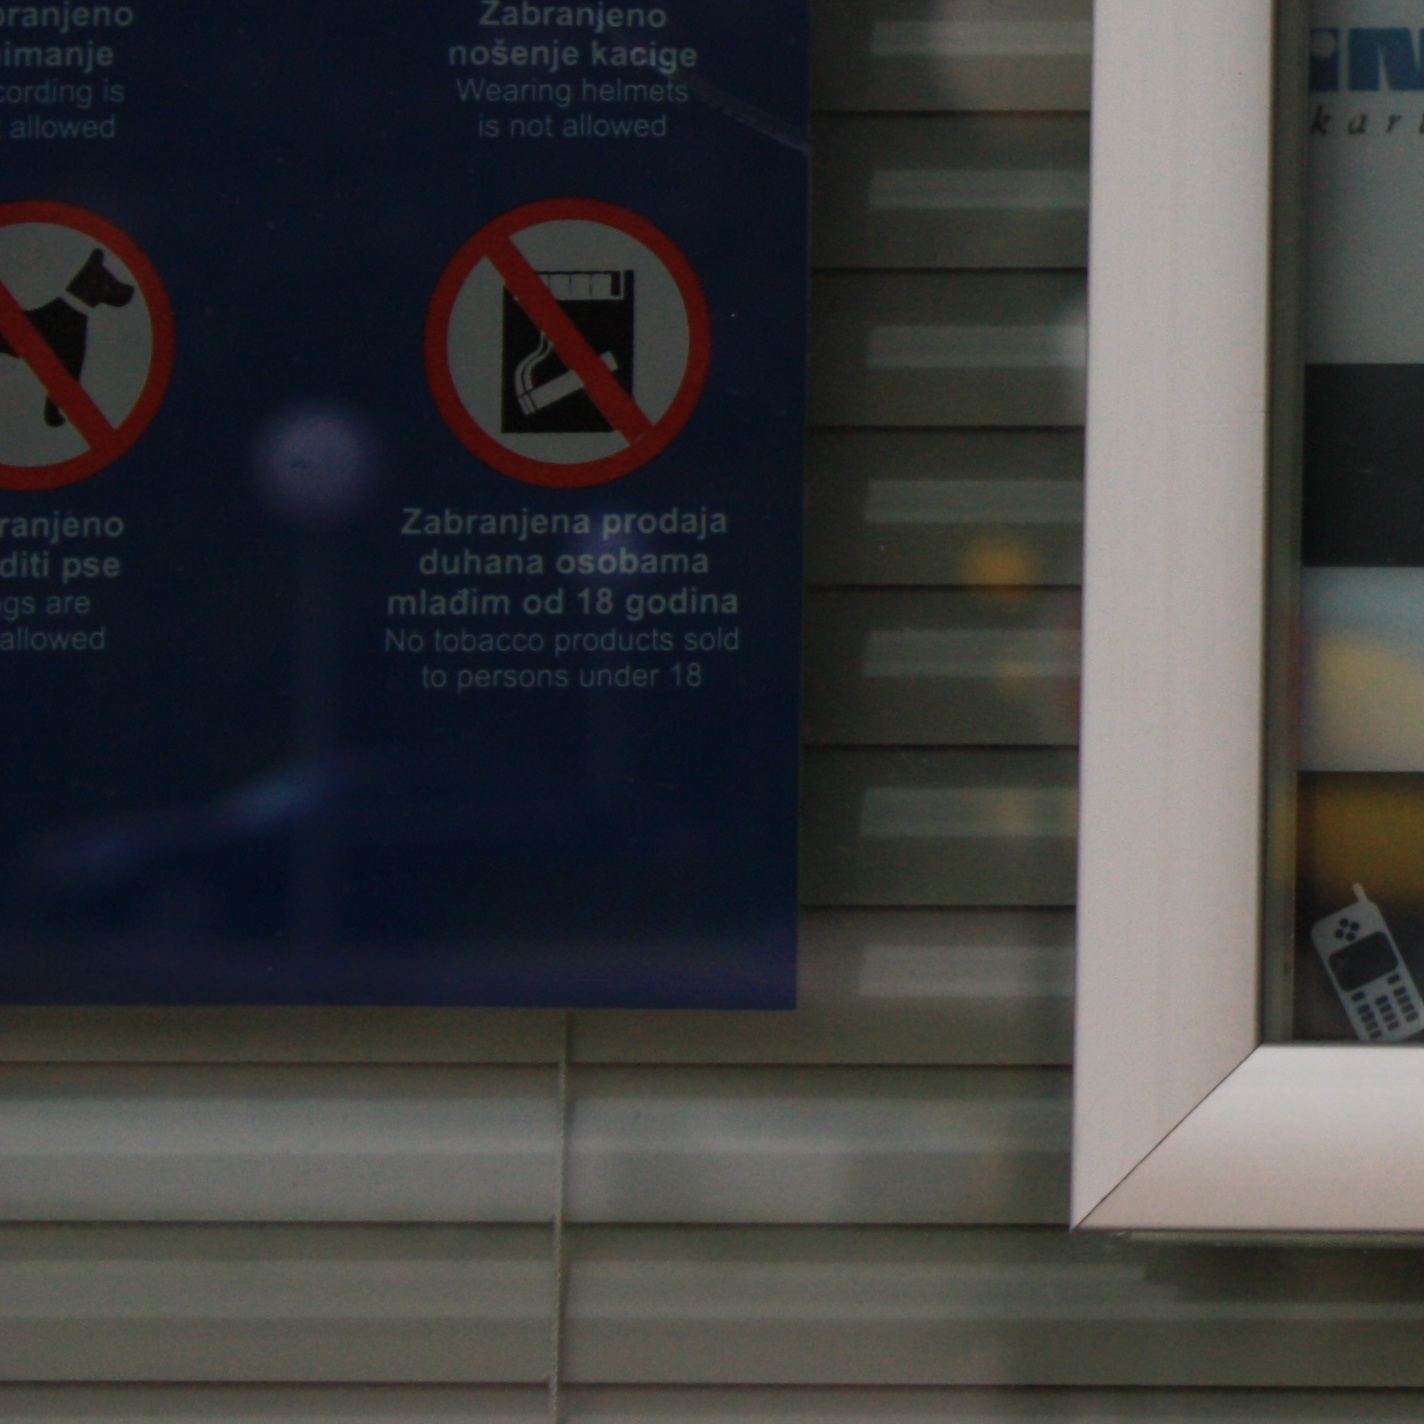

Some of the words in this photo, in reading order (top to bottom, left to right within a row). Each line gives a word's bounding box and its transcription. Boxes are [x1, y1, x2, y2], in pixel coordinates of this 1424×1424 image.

[479, 0, 667, 33] Zabranjeno
[449, 39, 579, 72] nošenje
[592, 41, 696, 74] kacige
[103, 79, 125, 104] is
[456, 78, 571, 108] Wearing
[582, 78, 688, 104] helmets
[10, 114, 116, 139] allowed
[478, 114, 498, 138] is
[510, 115, 553, 138] not
[562, 114, 667, 138] allowed
[401, 508, 589, 541] Zabranjena
[602, 507, 727, 540] prodaja
[62, 555, 121, 585] pse
[419, 548, 543, 575] duhana
[556, 547, 709, 575] osobama
[46, 595, 91, 615] are
[522, 588, 563, 615] od
[578, 587, 613, 615] 18
[625, 588, 739, 622] godina
[0, 625, 107, 651] allowed
[385, 628, 424, 653] No
[435, 628, 544, 652] tobacco
[555, 627, 674, 657] products
[684, 627, 740, 651] sold
[422, 665, 447, 689] to
[458, 667, 569, 694] persons
[580, 664, 660, 688] under
[673, 662, 702, 687] 18
